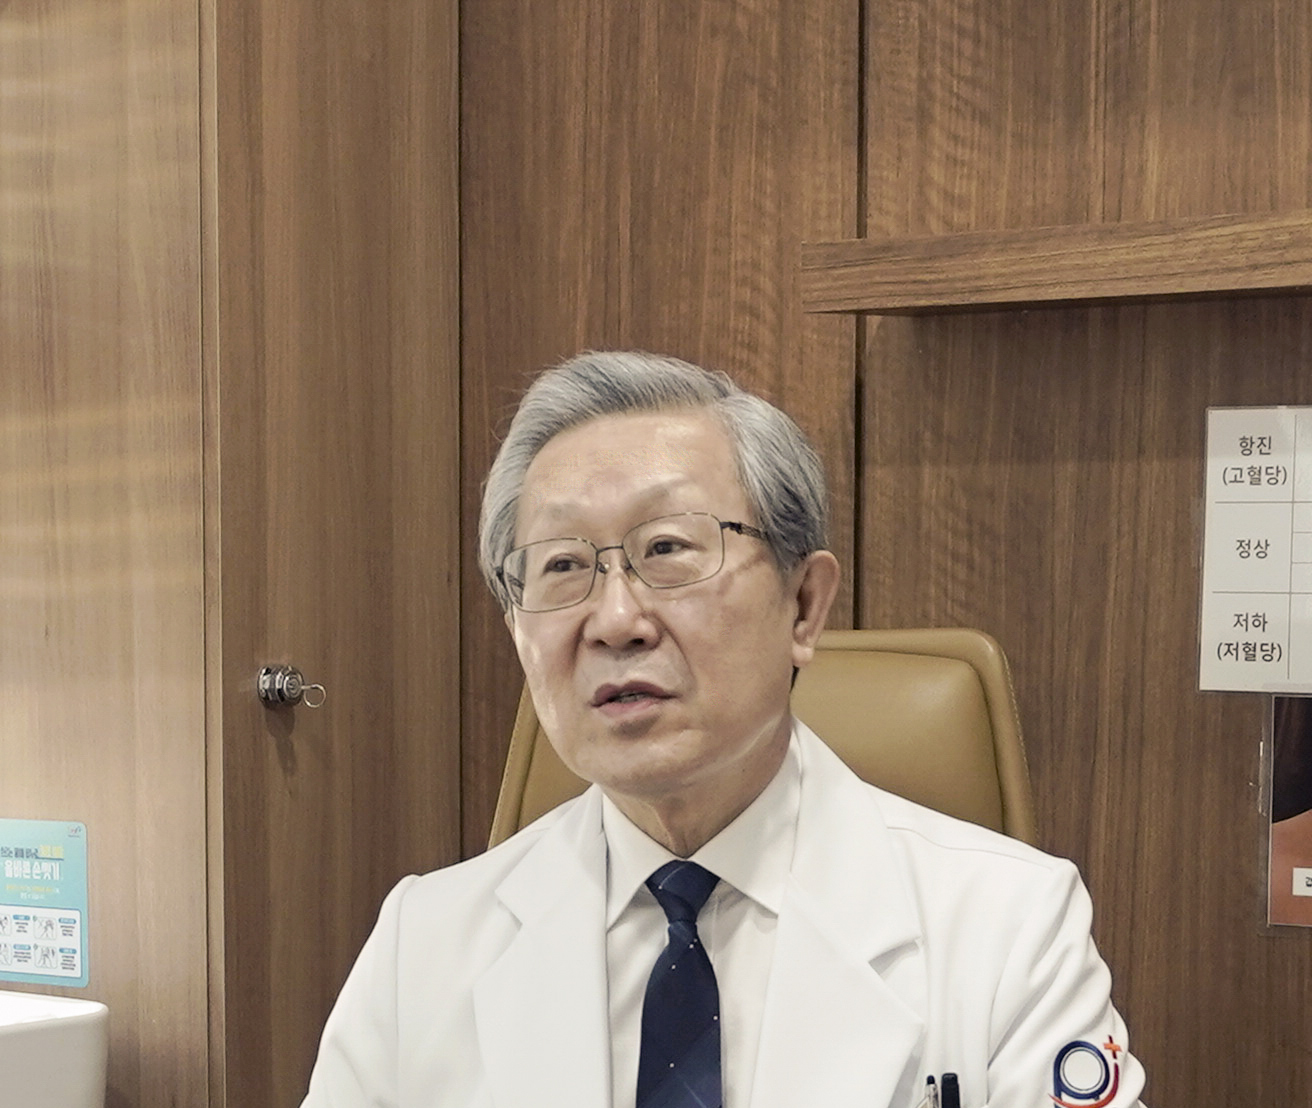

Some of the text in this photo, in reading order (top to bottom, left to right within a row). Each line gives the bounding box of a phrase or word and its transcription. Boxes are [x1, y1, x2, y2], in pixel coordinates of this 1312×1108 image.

[1239, 436, 1273, 456] 항진
[1222, 466, 1288, 486] (고혈당)
[1235, 539, 1271, 559] 정상
[1233, 612, 1268, 633] 저하
[1217, 641, 1283, 663] (저혈당)
